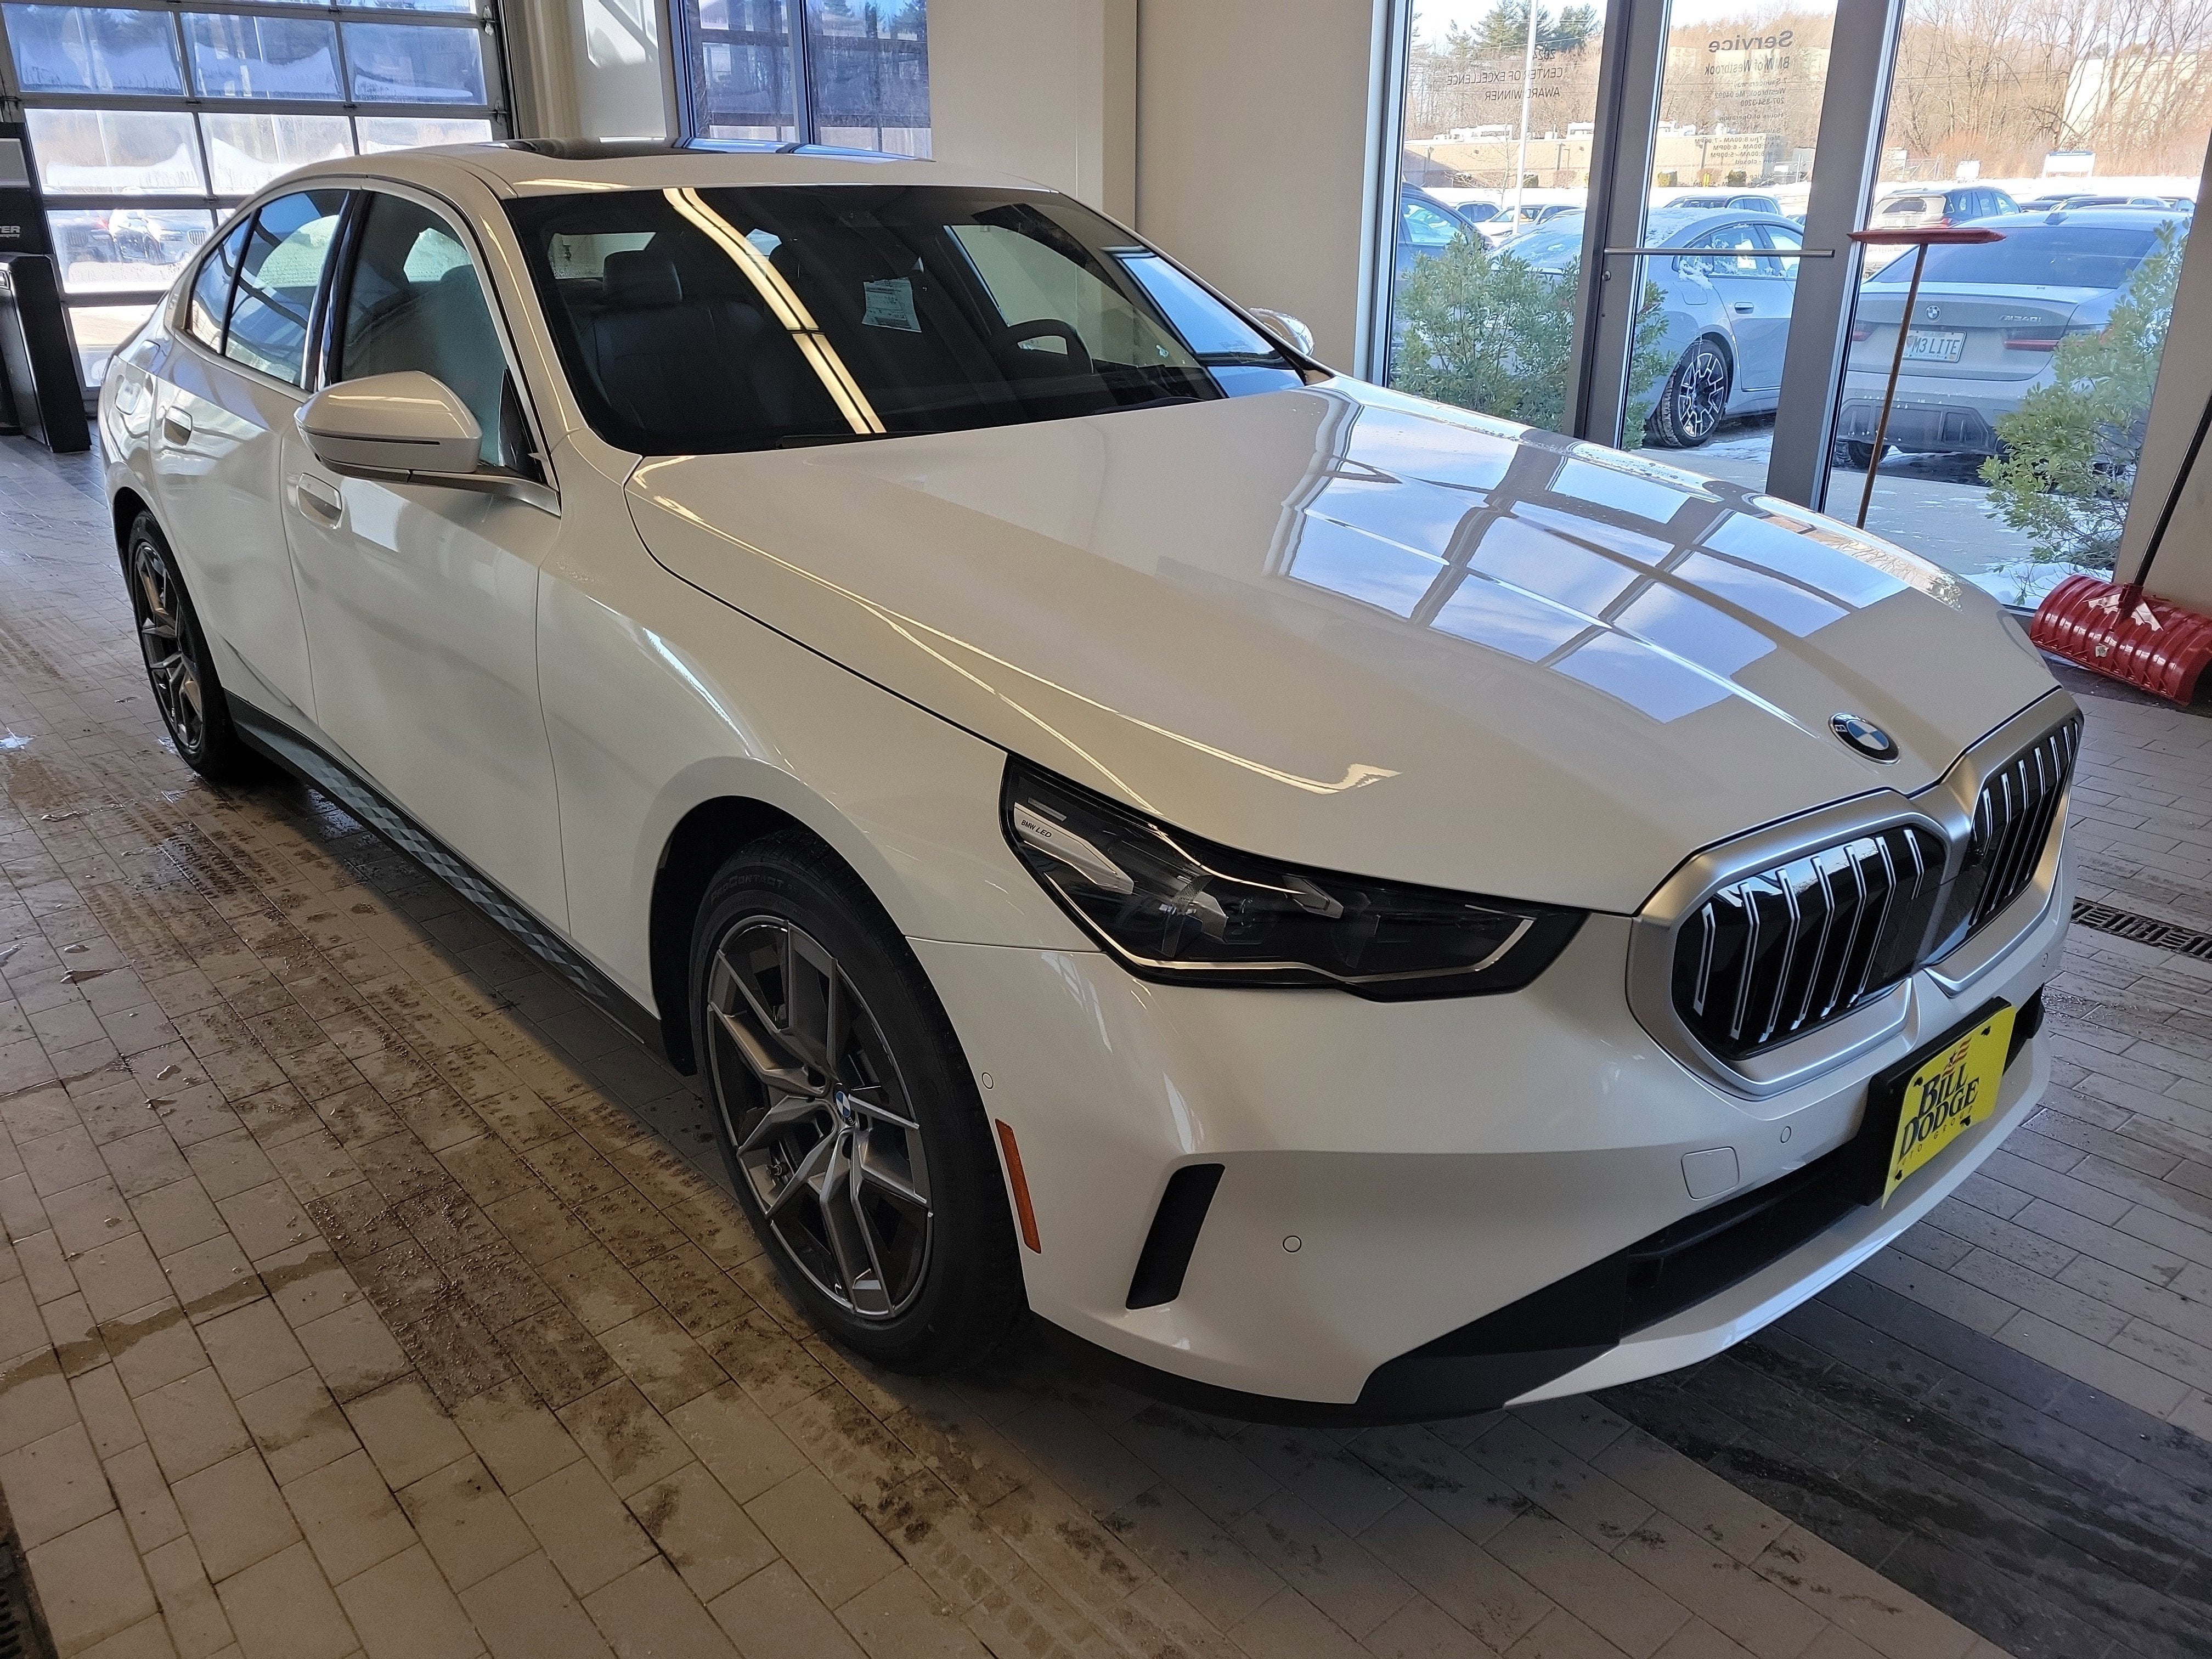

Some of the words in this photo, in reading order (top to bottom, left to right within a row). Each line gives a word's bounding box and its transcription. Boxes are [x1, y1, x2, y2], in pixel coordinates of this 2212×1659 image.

[1911, 337, 1928, 353] M3
[1928, 338, 1960, 354] LITE
[1021, 819, 1036, 830] BMW
[1035, 827, 1052, 838] LED
